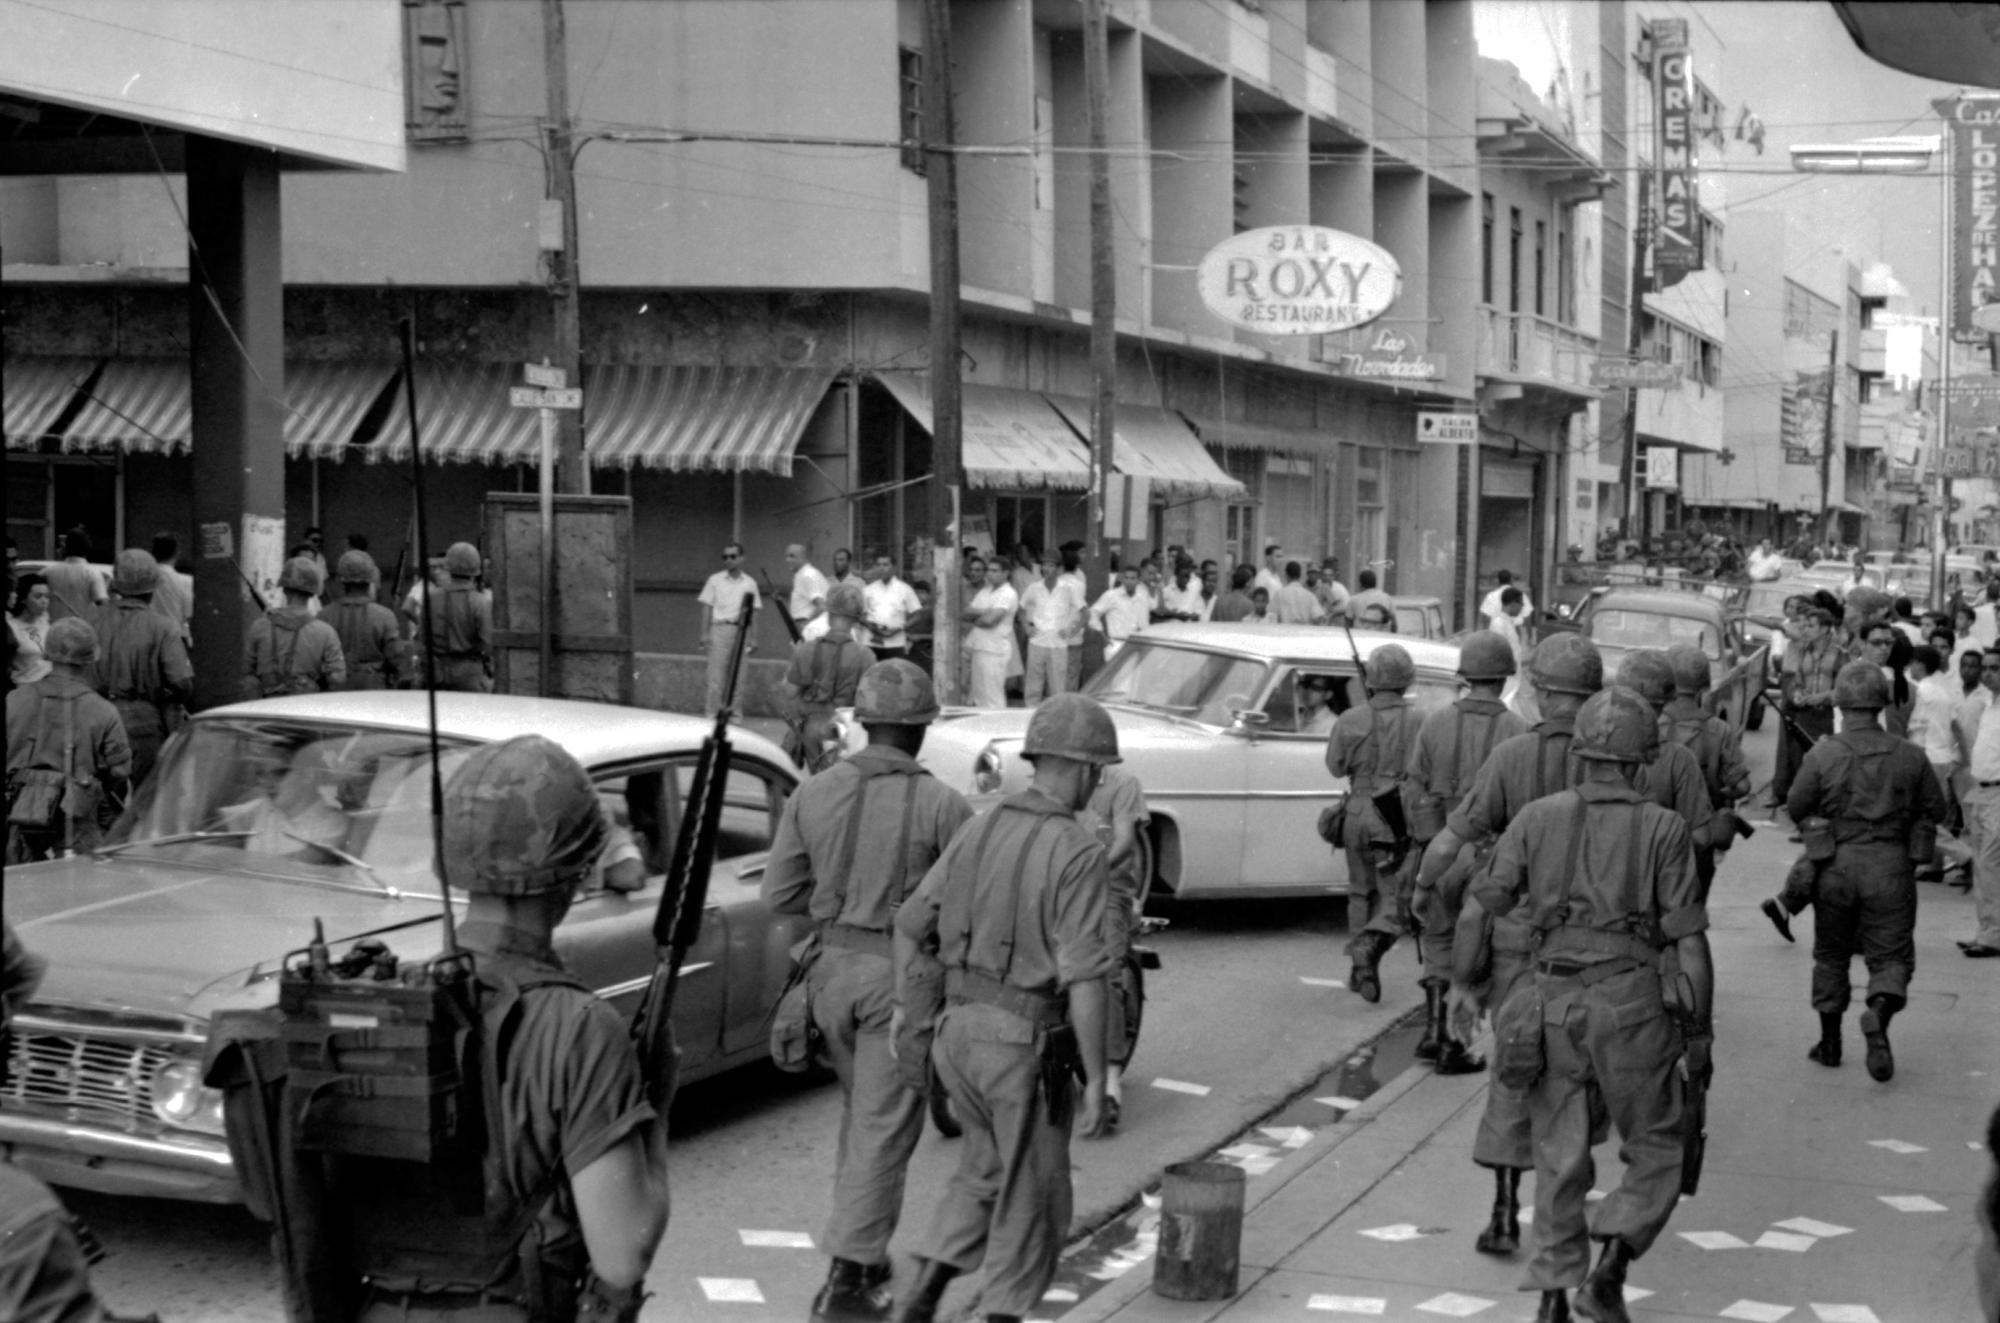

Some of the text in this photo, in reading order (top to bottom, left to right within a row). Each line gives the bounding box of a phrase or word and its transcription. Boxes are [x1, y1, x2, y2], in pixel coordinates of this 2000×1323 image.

[1972, 130, 1996, 229] LOPEZ
[1268, 232, 1330, 251] BAR
[1227, 257, 1371, 303] ROXY
[1242, 304, 1360, 322] RESTAURANT
